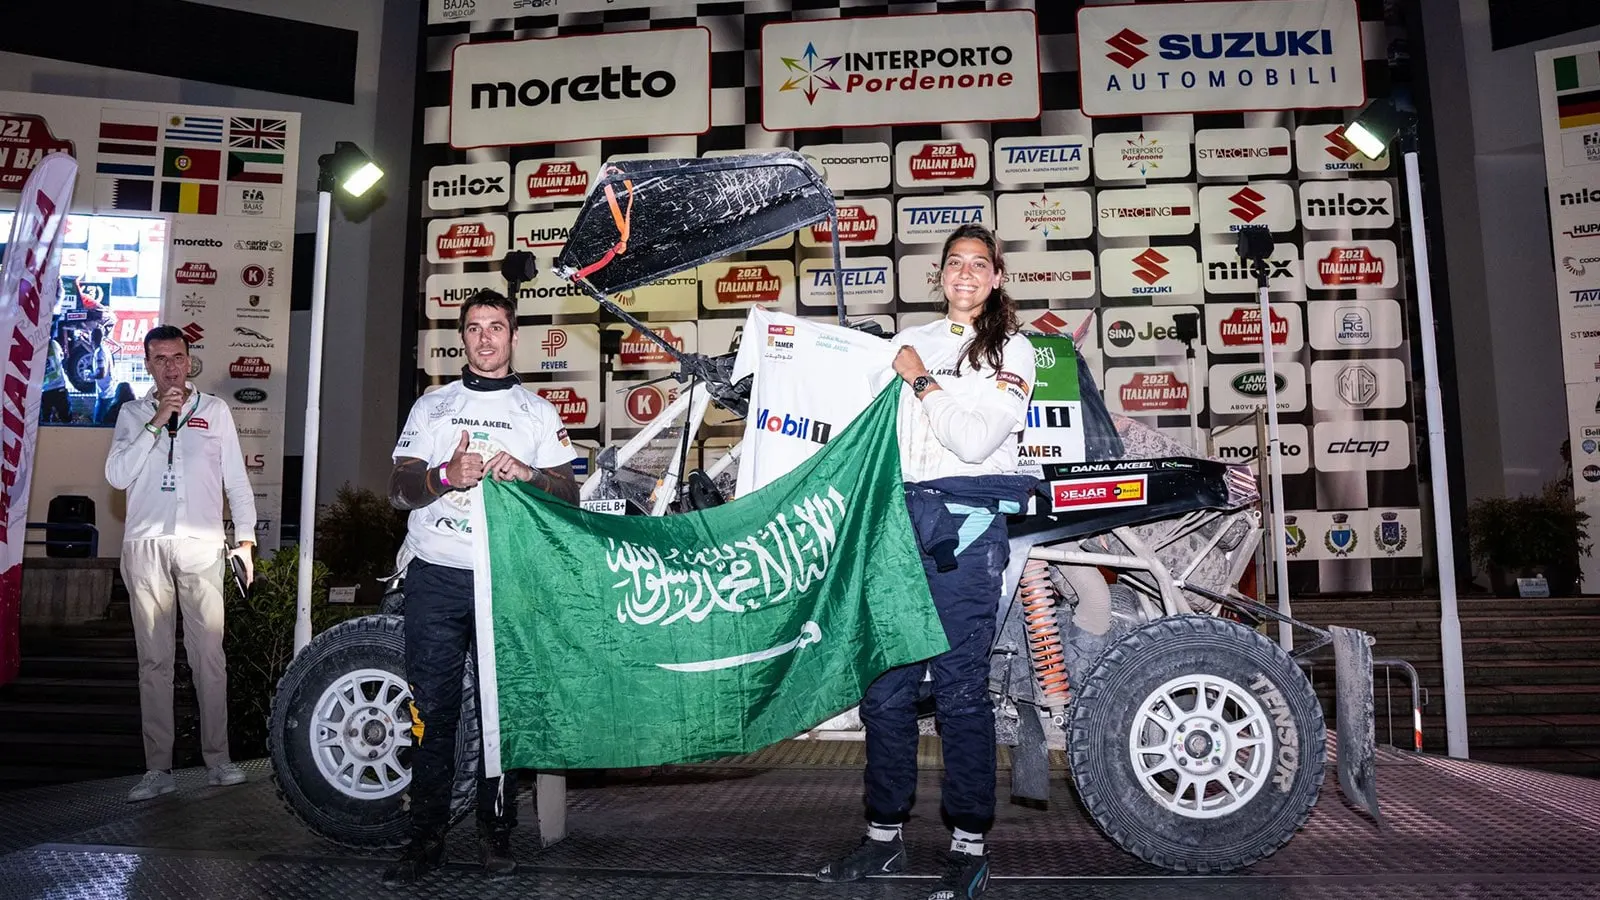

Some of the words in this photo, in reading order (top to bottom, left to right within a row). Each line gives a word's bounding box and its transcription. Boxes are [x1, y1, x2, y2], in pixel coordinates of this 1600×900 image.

[1158, 30, 1332, 60] SUZUKI
[845, 46, 1013, 72] INTERPORTO
[846, 70, 1013, 94] Pordenone
[1106, 66, 1337, 92] AUTOMOBILI
[471, 65, 676, 110] moretto
[932, 146, 957, 154] 2021
[1001, 144, 1082, 163] TAVELLA
[13, 148, 68, 170] BA
[821, 156, 888, 165] CODOGNOTTO
[912, 158, 948, 170] ITALIAN
[951, 156, 975, 169] BAJA
[2, 174, 22, 182] CUP
[530, 177, 563, 188] ITALIAN
[564, 174, 586, 186] BAJA
[433, 175, 505, 197] nilox
[1308, 193, 1390, 216] nilox
[903, 206, 984, 225] TAVELLA
[457, 225, 479, 234] 2021
[814, 220, 850, 232] ITALAN
[852, 218, 875, 231] BAJA
[531, 228, 571, 241] HUPA
[174, 238, 222, 247] moretto
[439, 238, 471, 249] ITALIAN
[473, 235, 494, 247] BAJA
[1339, 250, 1364, 259] 2021
[737, 268, 762, 278] 2021
[1321, 261, 1357, 274] ITALIAN
[1359, 261, 1382, 273] BAJA
[648, 278, 696, 286] OGNOTTO
[718, 281, 754, 293] ITALIAN
[756, 279, 779, 291] BAJA
[1108, 329, 1134, 339] SINA
[1138, 322, 1178, 340] Jee
[1223, 322, 1261, 335] ITALIAN
[621, 343, 657, 353] ITALIAN
[541, 361, 567, 370] PEVERE
[1142, 375, 1169, 384] 2021
[546, 390, 570, 399] 2021
[1123, 388, 1160, 400] ITALIAN
[1162, 387, 1187, 399] BAJA
[564, 402, 586, 413] BAJA
[637, 395, 652, 414] K
[451, 418, 480, 426] DANIA
[482, 420, 512, 430] AKEEL
[1018, 446, 1062, 458] AMER
[1220, 442, 1301, 458] morto
[1327, 439, 1390, 458] atap
[1114, 461, 1153, 470] AKEEL
[1251, 671, 1299, 793] TENSOR
